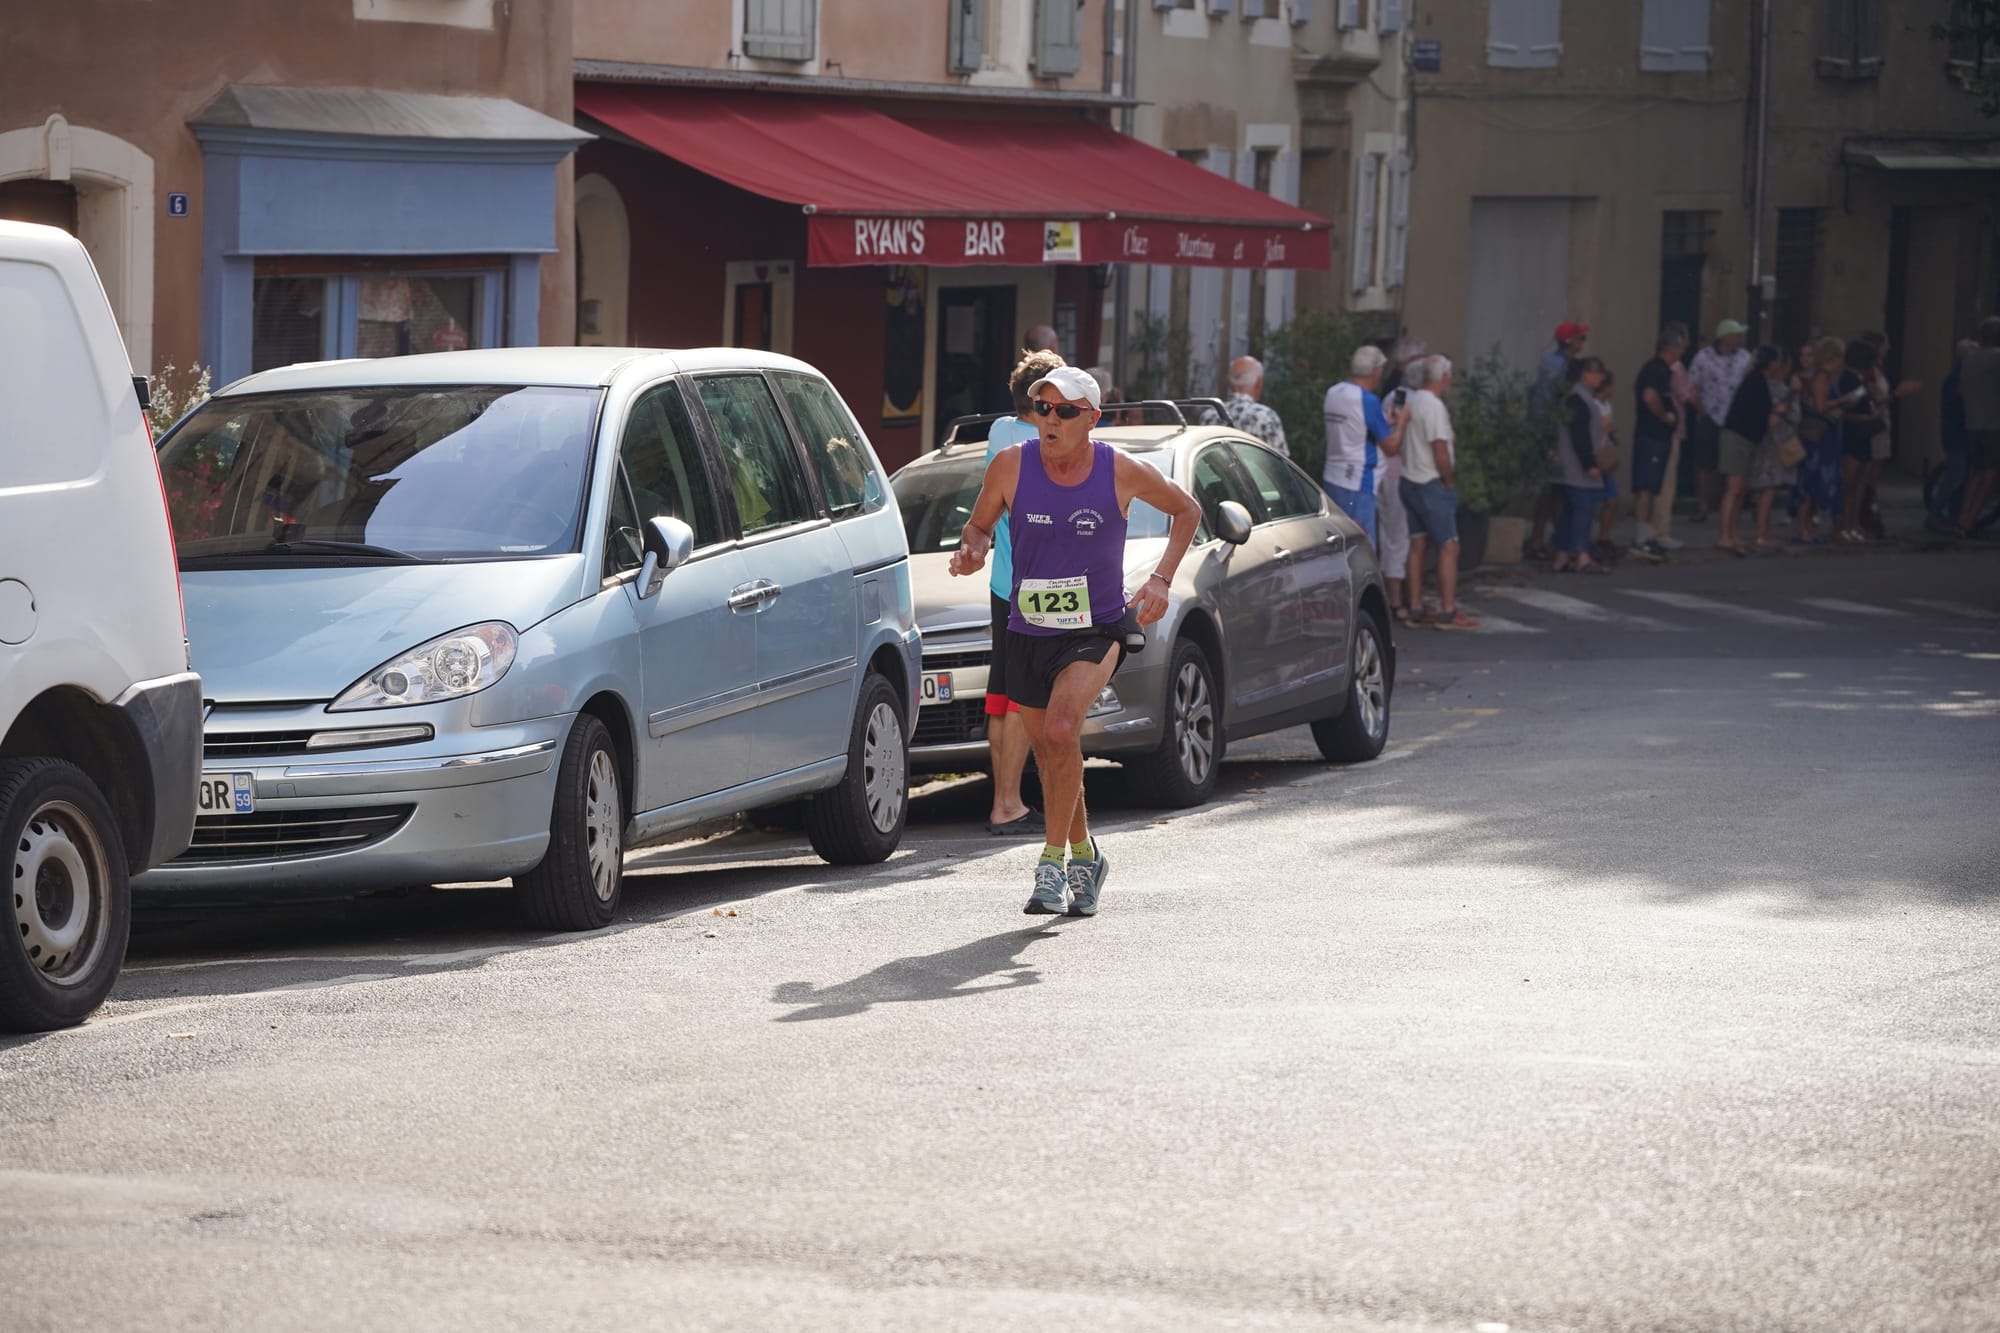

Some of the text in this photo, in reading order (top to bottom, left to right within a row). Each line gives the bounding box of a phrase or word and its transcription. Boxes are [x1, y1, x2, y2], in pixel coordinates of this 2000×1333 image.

[175, 196, 182, 213] 6
[855, 219, 1005, 256] RYAN'S BAR
[1123, 225, 1149, 256] Chez
[1233, 240, 1244, 260] et
[1263, 234, 1286, 267] John
[1028, 591, 1079, 612] 123
[940, 687, 950, 699] 48
[235, 793, 250, 807] 59
